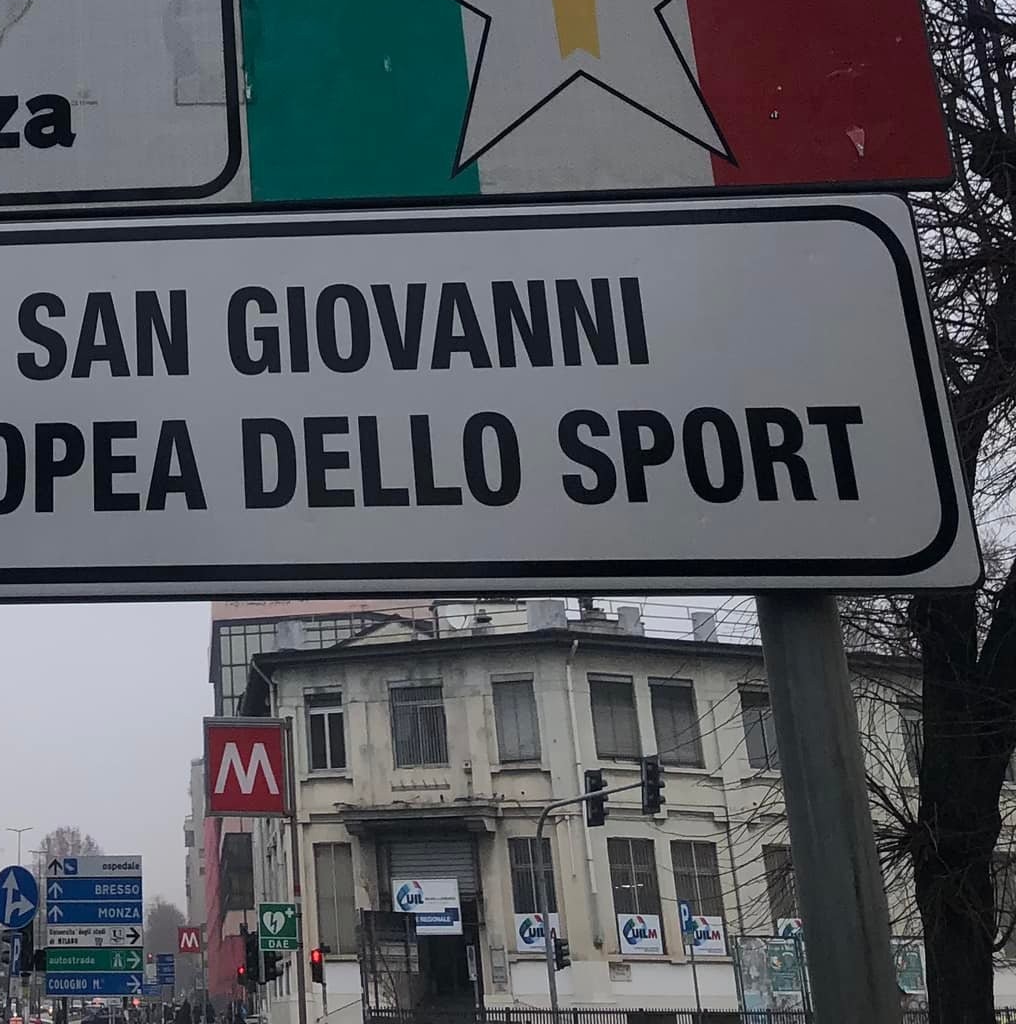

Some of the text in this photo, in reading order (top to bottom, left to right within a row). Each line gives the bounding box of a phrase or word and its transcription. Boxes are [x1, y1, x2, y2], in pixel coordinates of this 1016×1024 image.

[18, 290, 189, 380] SAN
[228, 278, 649, 375] GIOVANNI
[242, 412, 521, 509] DELLO
[558, 406, 863, 505] SPORT
[214, 742, 280, 794] M
[102, 861, 140, 871] ospedale
[95, 884, 140, 895] BRESSO
[406, 893, 424, 905] UIL
[98, 908, 140, 919] MONZA
[681, 903, 689, 932] P
[632, 929, 657, 939] UILM
[696, 930, 721, 940] UILM
[180, 932, 199, 948] M
[268, 939, 289, 948] DAE
[48, 979, 87, 990] COLOGNO
